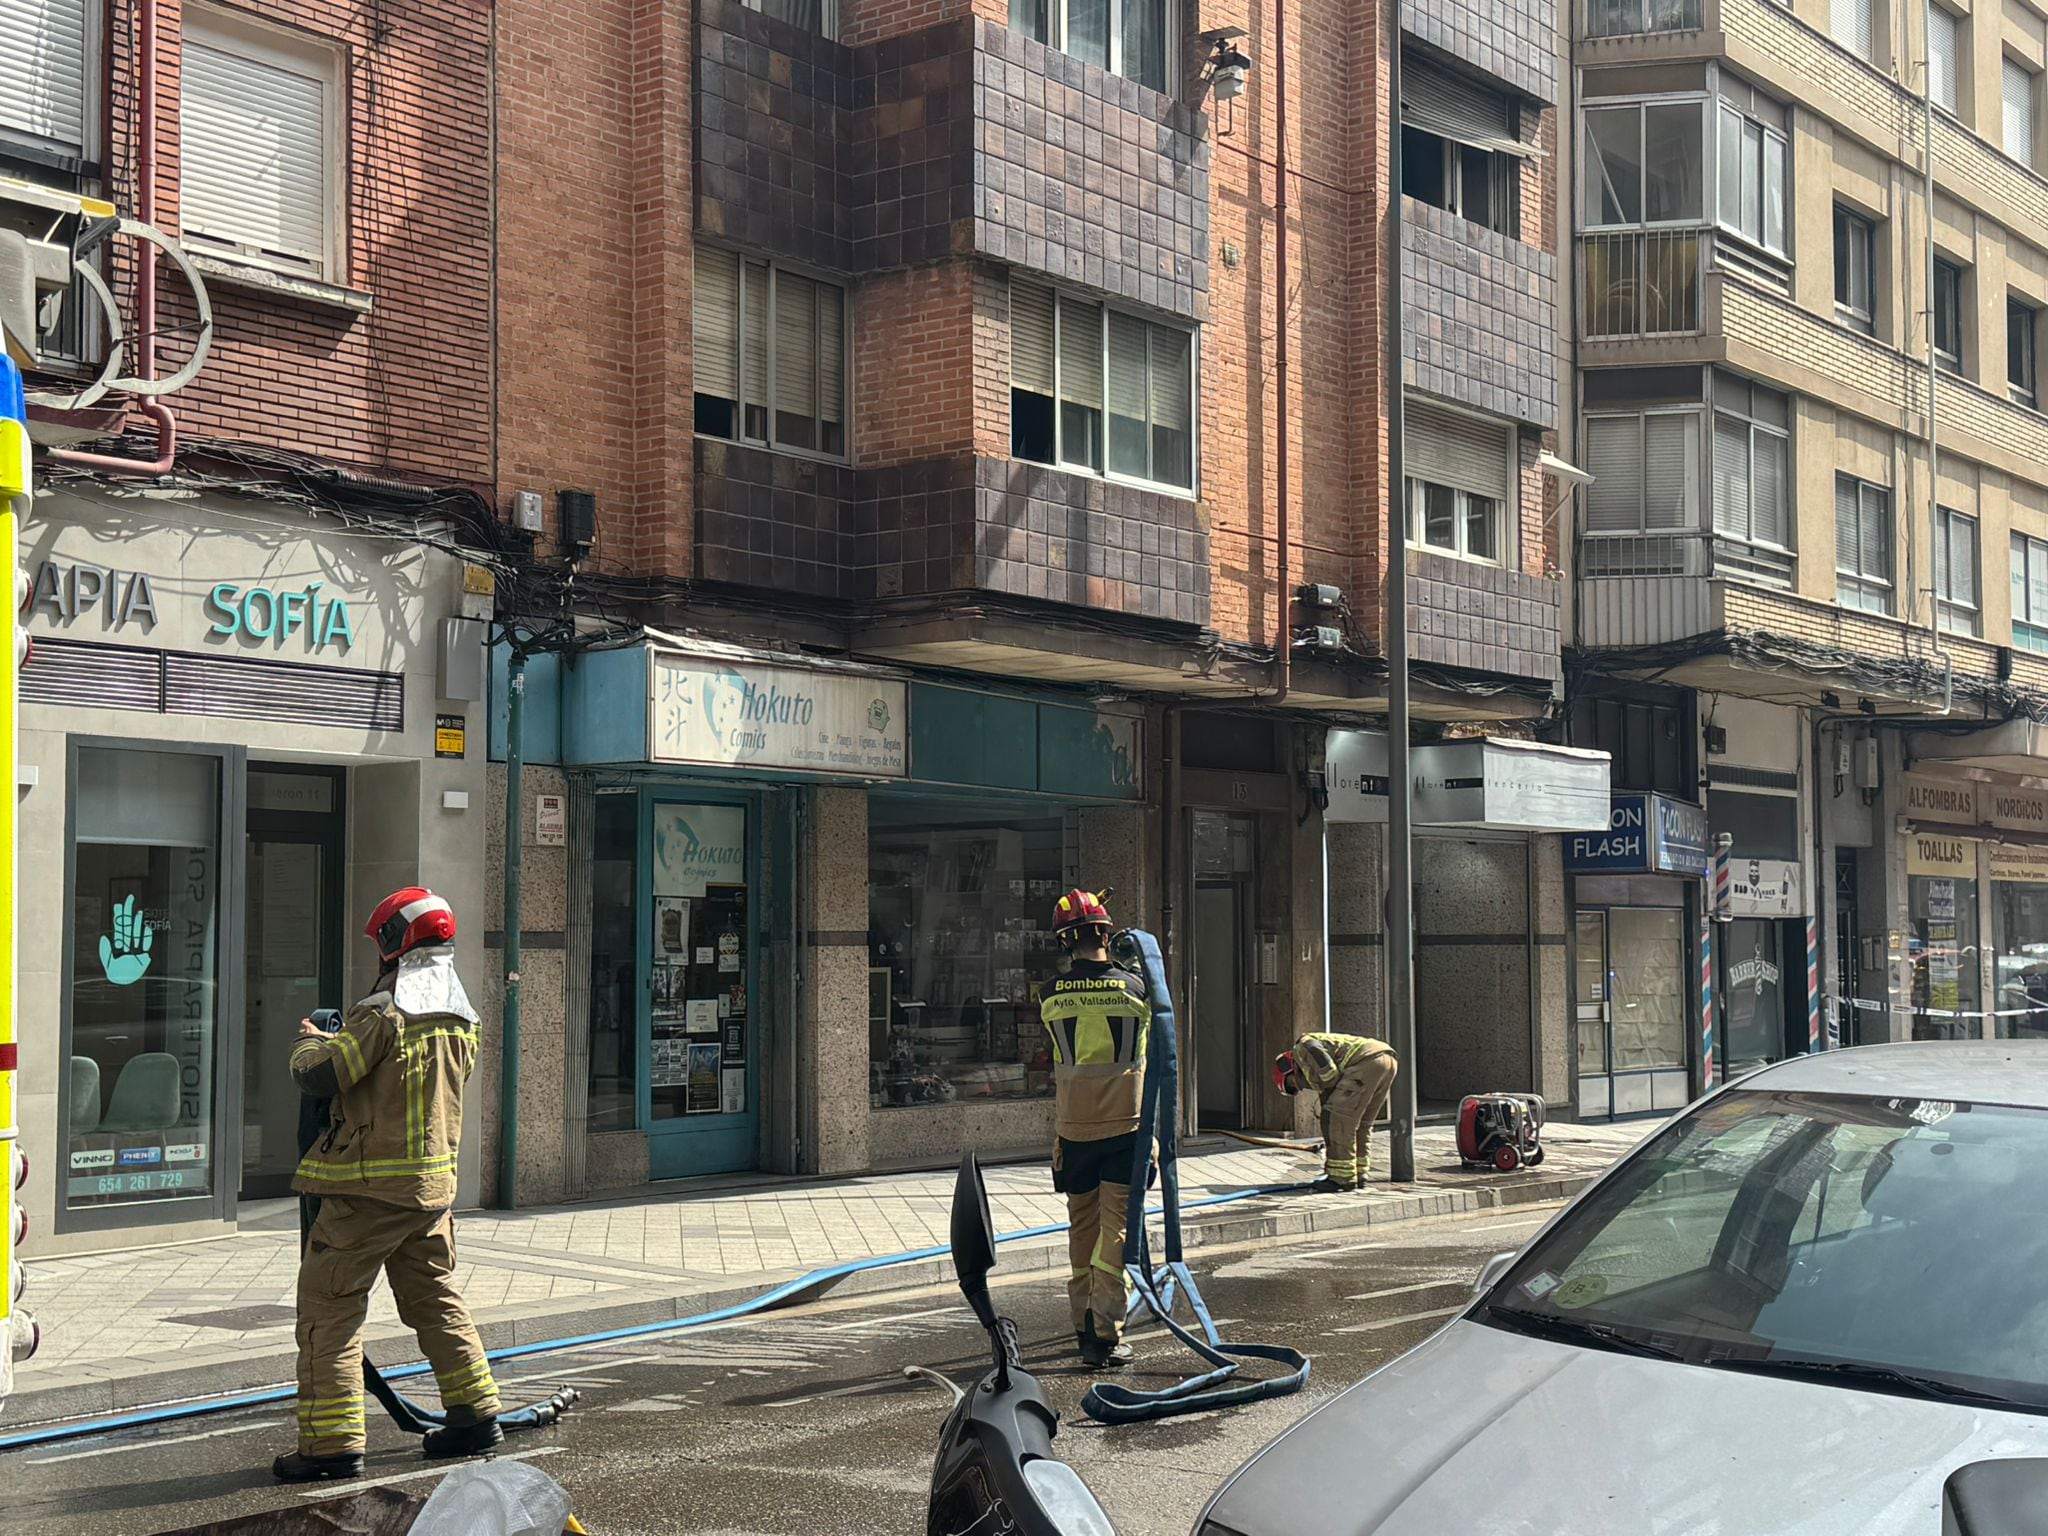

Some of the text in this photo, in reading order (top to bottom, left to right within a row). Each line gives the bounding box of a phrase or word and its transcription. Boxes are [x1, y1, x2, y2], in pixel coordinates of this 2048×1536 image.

[31, 560, 353, 646] APIA SOFÍA
[662, 668, 693, 747] 北斗
[738, 683, 814, 726] Hokuto
[730, 728, 767, 750] Comics
[1908, 787, 1971, 813] ALFOMBRAS
[1610, 807, 1642, 828] ON
[1573, 836, 1640, 858] FLASH
[1917, 840, 1963, 863] TOALLAS
[1055, 977, 1127, 991] Bomberos
[73, 1155, 113, 1164] VINNO
[98, 1173, 183, 1193] 654 261 729
